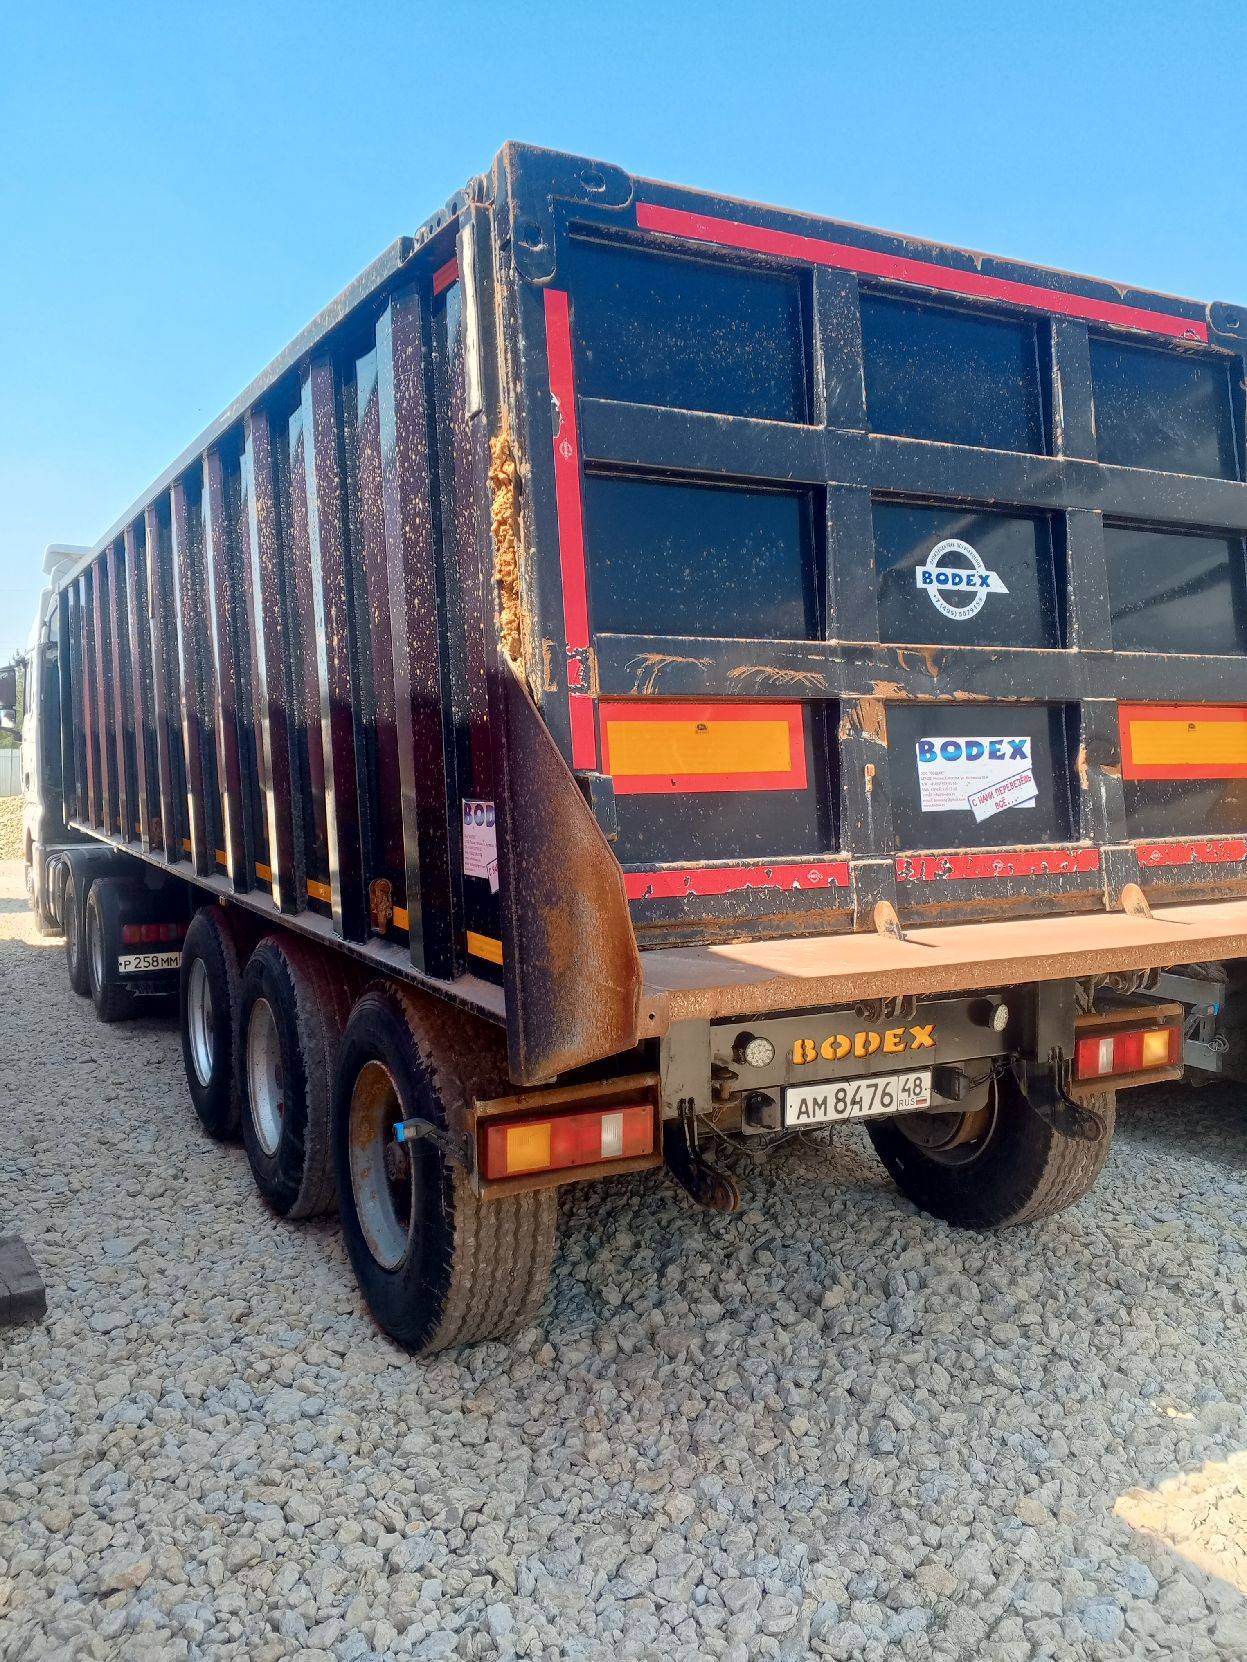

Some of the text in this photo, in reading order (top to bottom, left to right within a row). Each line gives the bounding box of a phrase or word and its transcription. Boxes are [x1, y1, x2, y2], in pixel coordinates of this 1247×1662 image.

[922, 570, 991, 588] BODEX
[918, 739, 1029, 763] BODEX
[792, 1023, 937, 1065] BODEX
[901, 1076, 923, 1098] 48
[898, 1097, 916, 1107] RUS
